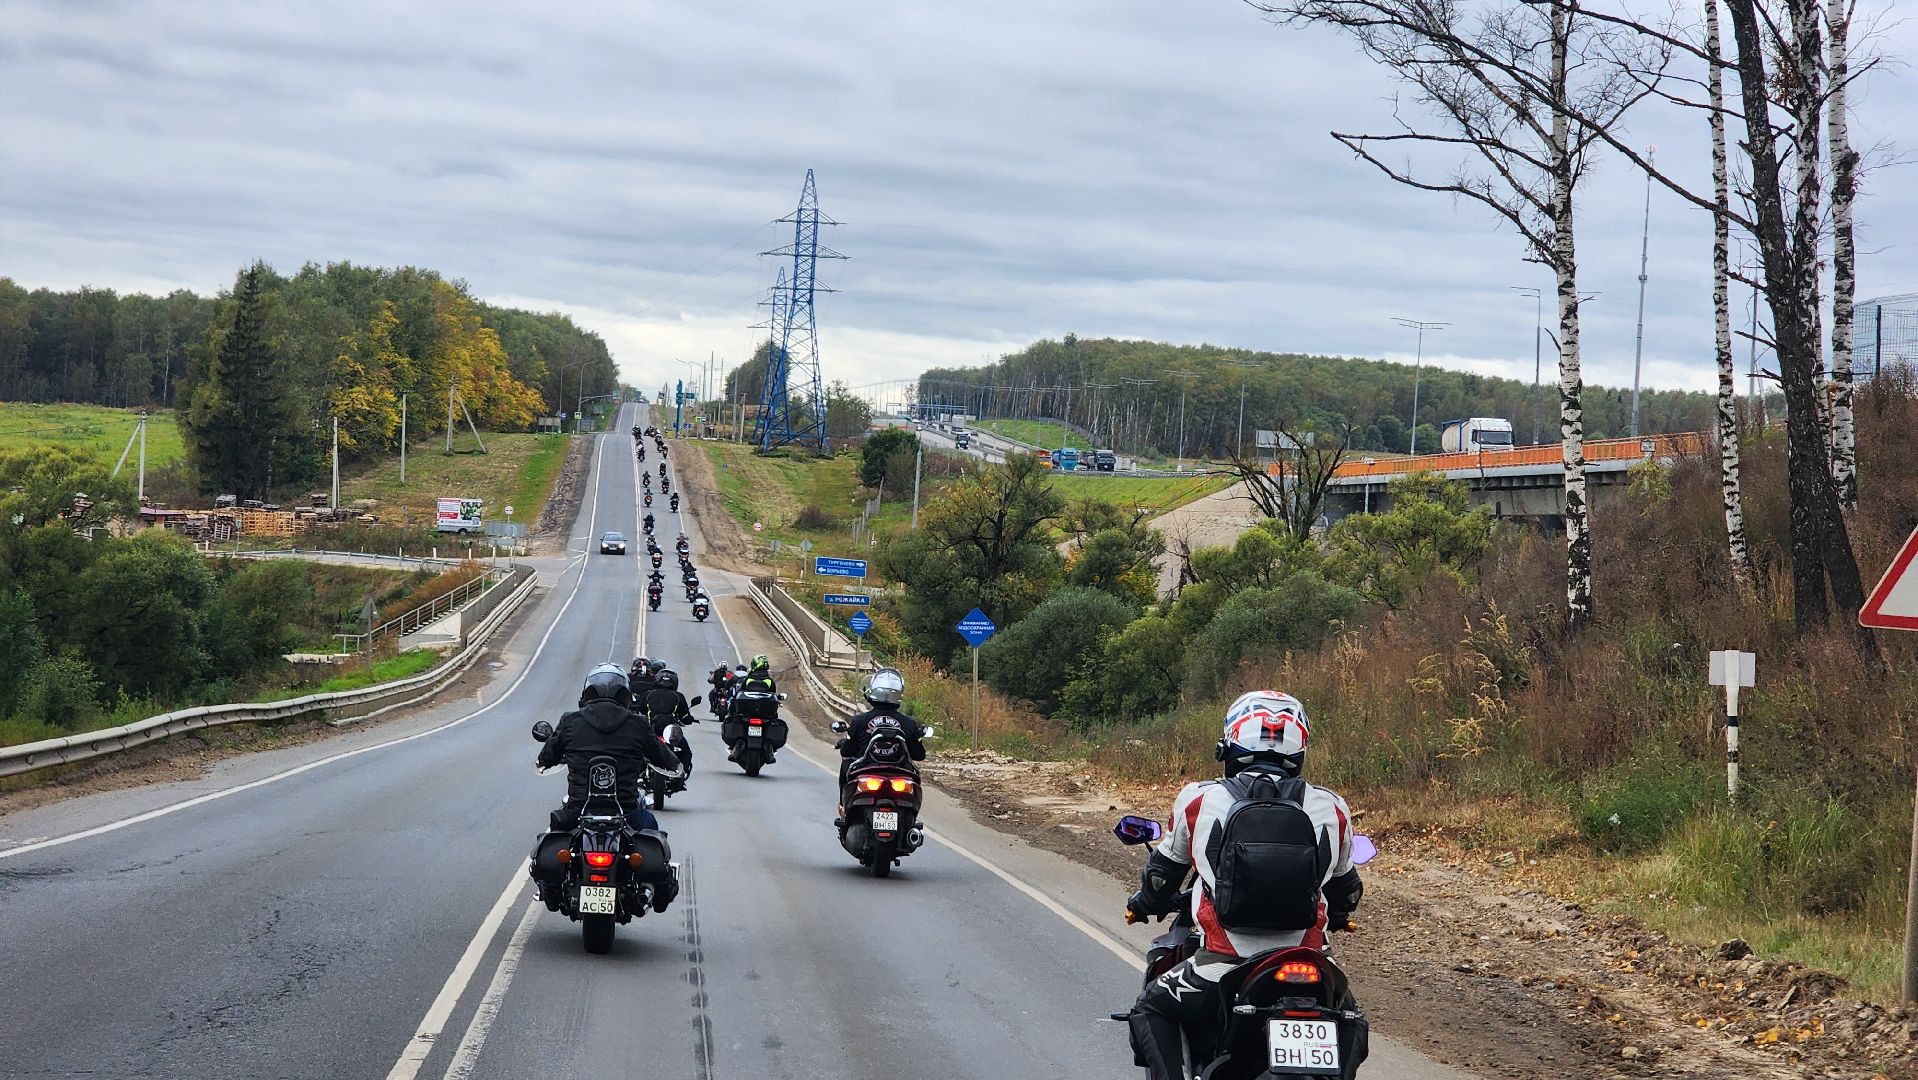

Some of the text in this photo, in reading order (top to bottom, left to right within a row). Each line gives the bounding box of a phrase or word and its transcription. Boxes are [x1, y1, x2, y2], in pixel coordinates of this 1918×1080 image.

[585, 887, 611, 898] 0382
[600, 902, 613, 912] 50
[1279, 1023, 1327, 1040] 3830
[1311, 1049, 1334, 1066] 50
